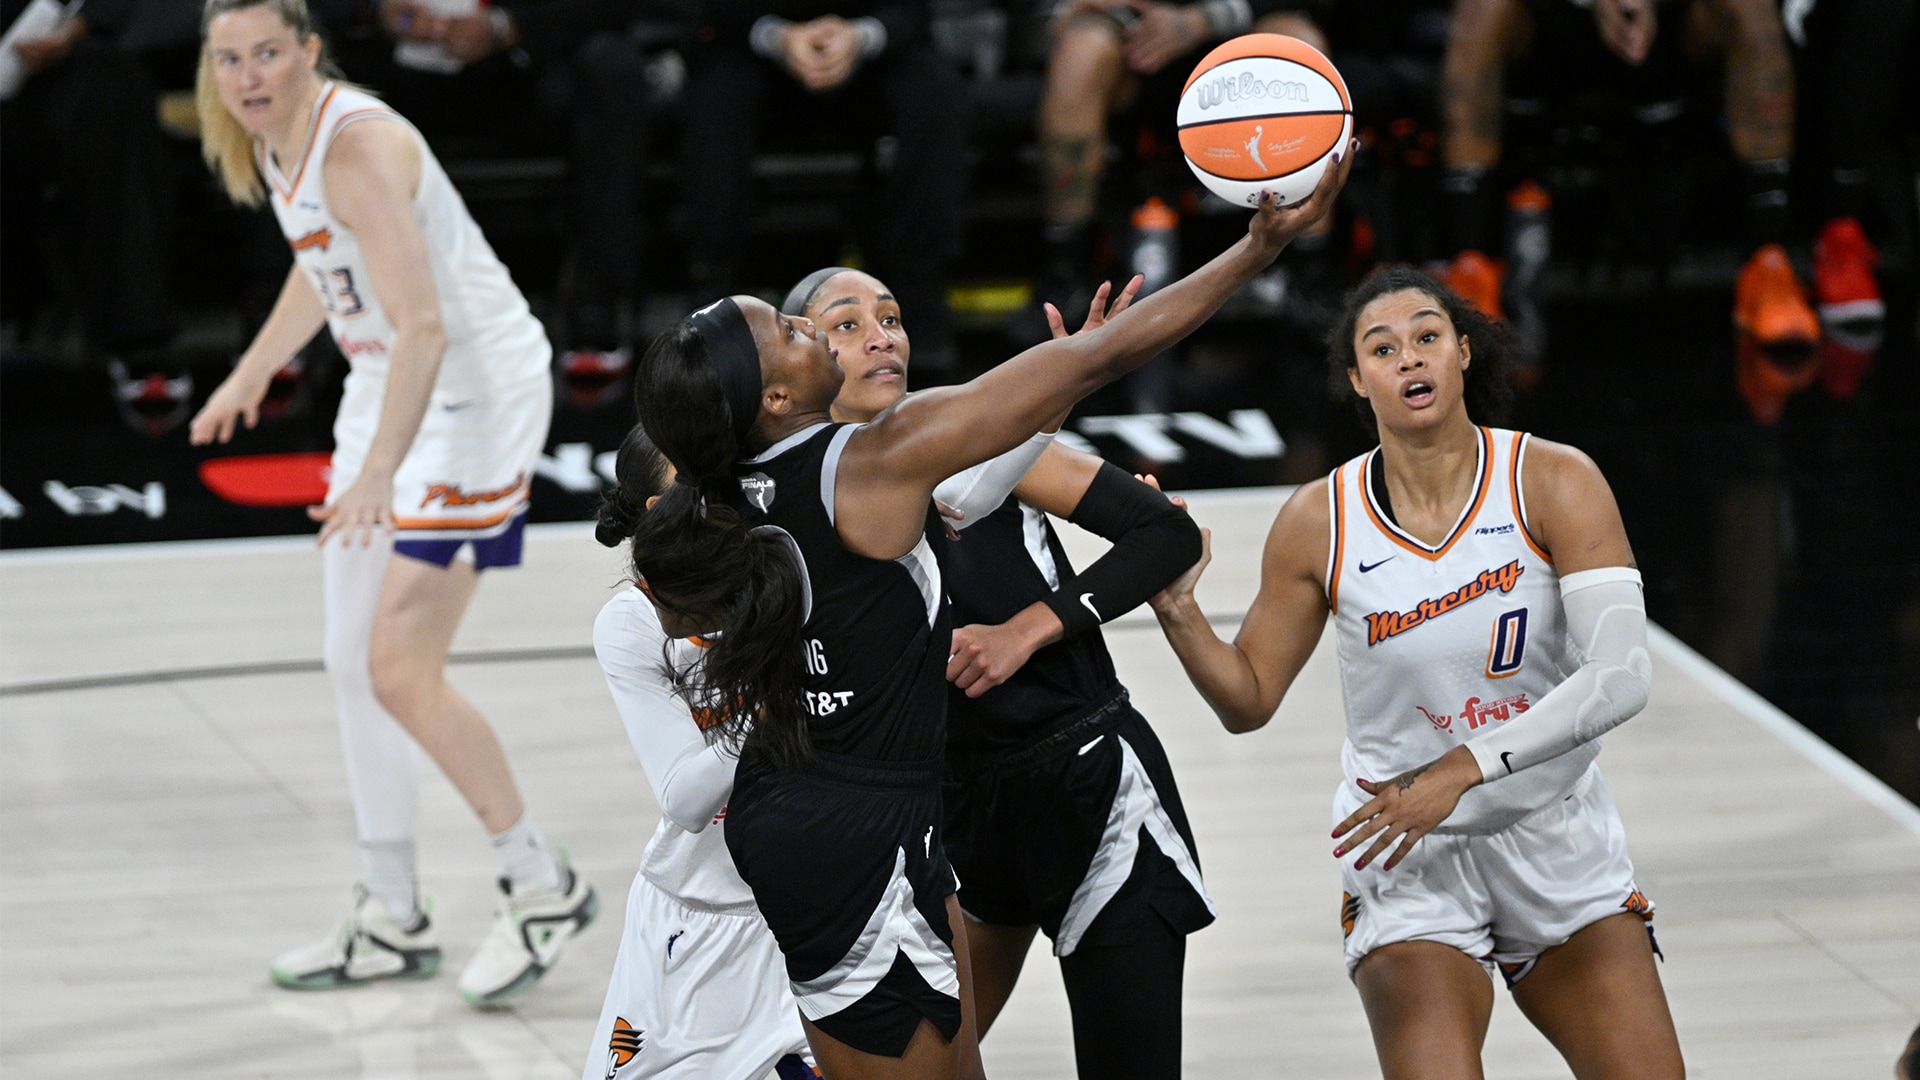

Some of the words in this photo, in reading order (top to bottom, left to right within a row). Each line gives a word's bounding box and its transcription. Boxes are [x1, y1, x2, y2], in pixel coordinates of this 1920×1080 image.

[1197, 71, 1309, 110] Wilson
[1077, 407, 1287, 463] TV
[741, 479, 775, 489] FINALS
[1363, 558, 1525, 648] Mercury
[1485, 607, 1528, 679] 0
[802, 688, 854, 716] T&T
[1459, 696, 1530, 730] fry's
